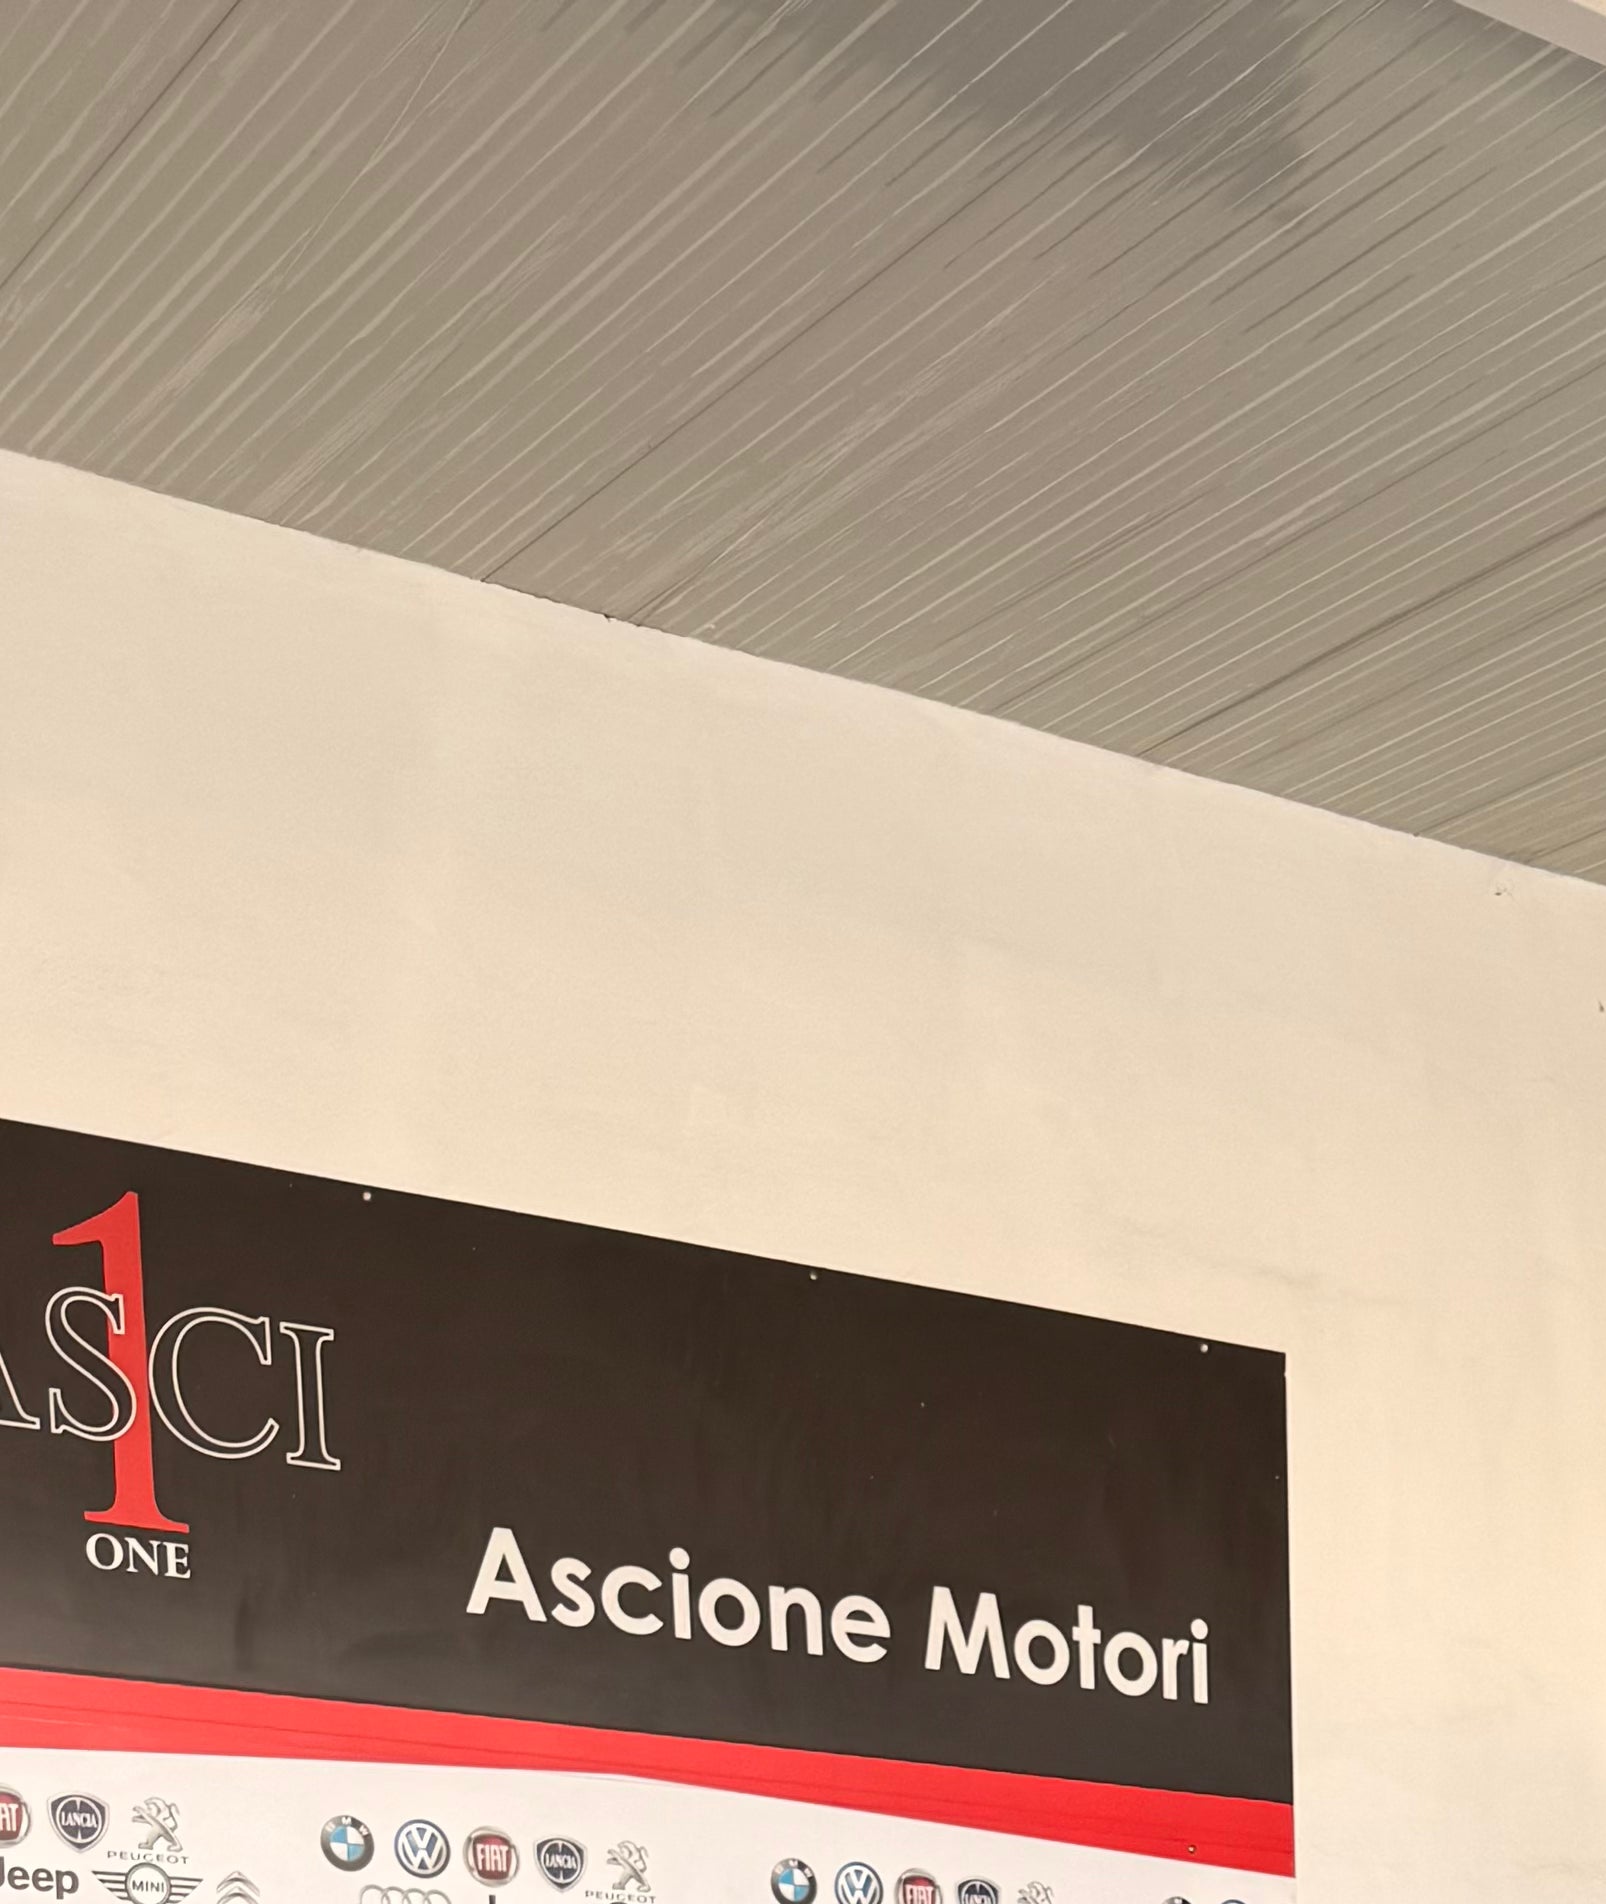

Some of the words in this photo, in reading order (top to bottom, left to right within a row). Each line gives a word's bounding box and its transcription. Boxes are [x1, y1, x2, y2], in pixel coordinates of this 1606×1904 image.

[85, 1532, 191, 1579] ONE
[466, 1527, 891, 1663] Ascione
[925, 1586, 1208, 1704] Motori
[61, 1810, 98, 1829] LANCIA
[107, 1850, 190, 1865] PEUGEOT
[477, 1843, 509, 1873] FIAT
[544, 1853, 579, 1871] LANCIA
[132, 1879, 165, 1894] MINI
[584, 1890, 657, 1904] PEUGEOT
